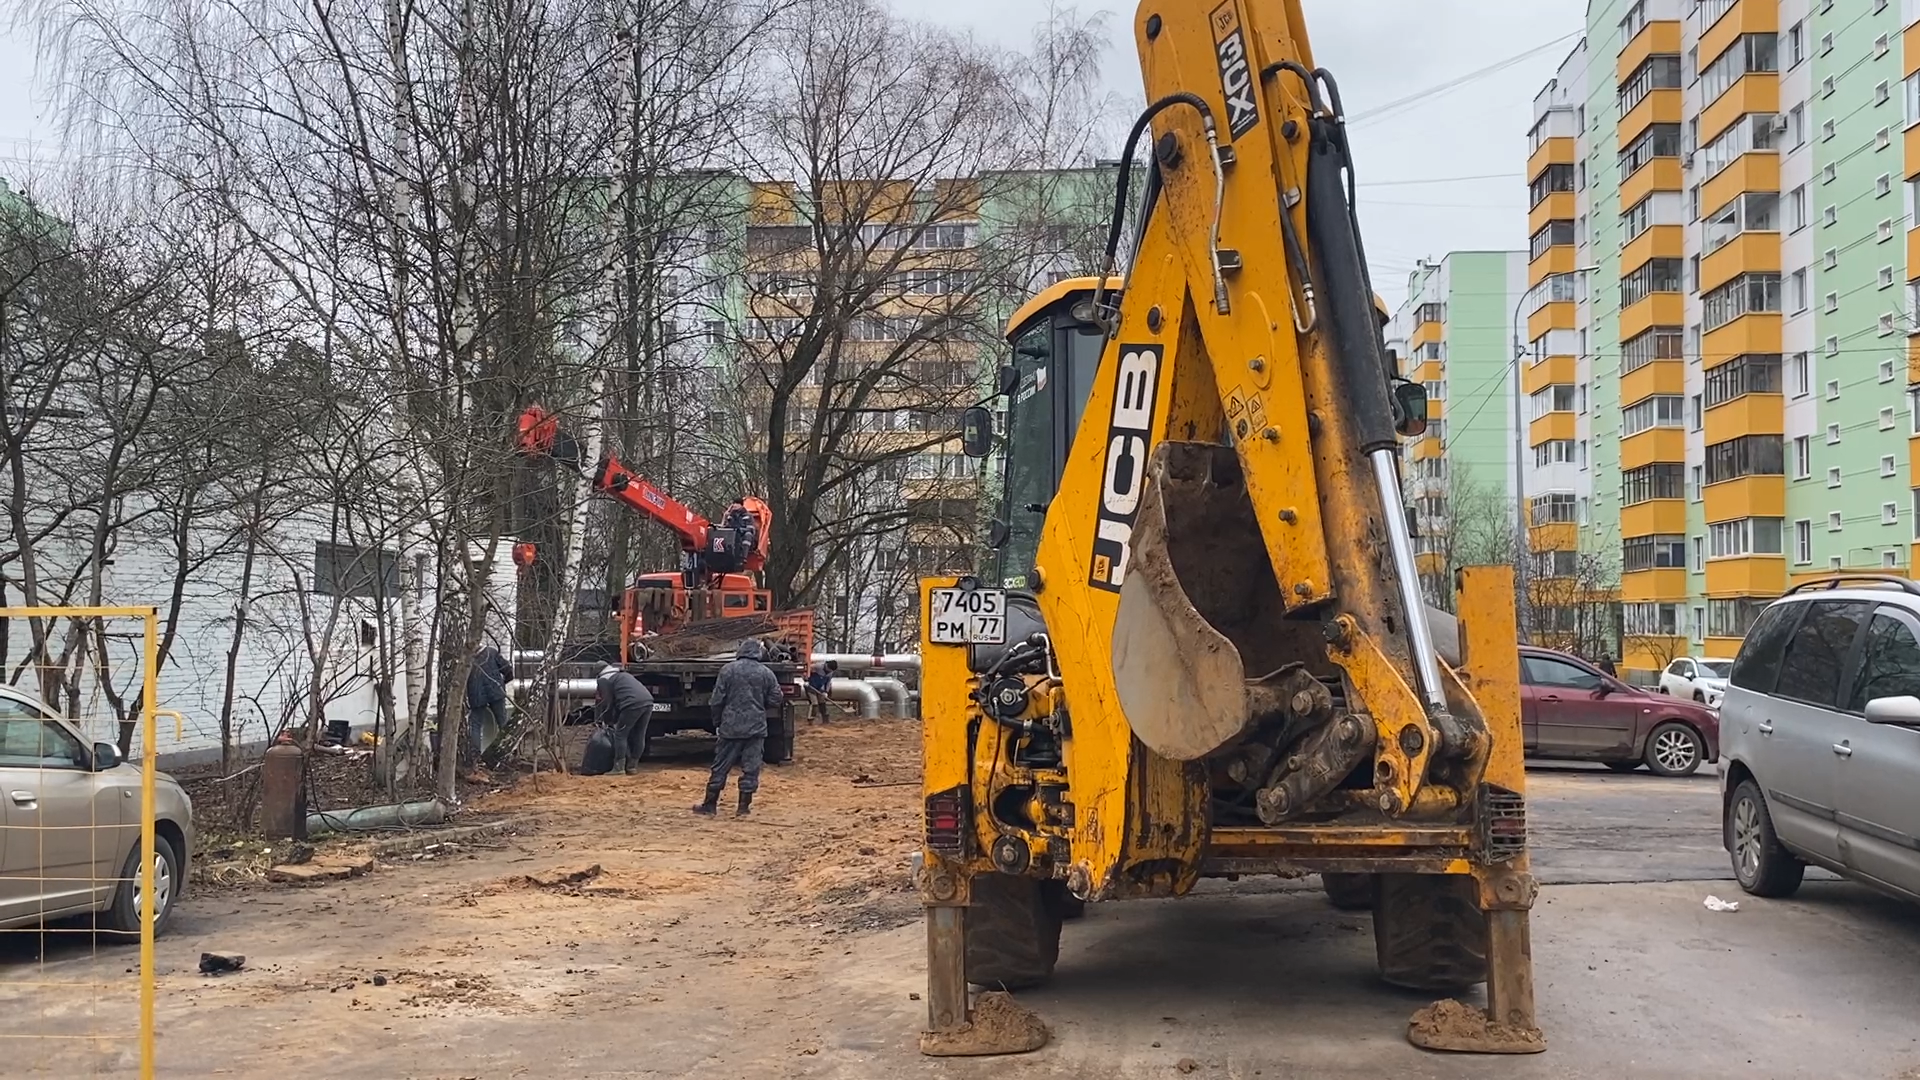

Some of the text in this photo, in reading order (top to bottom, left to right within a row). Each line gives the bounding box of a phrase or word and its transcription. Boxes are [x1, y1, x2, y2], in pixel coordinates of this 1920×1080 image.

[1219, 32, 1255, 126] 3CX
[1098, 350, 1157, 585] JCB
[942, 592, 996, 613] 7405
[978, 618, 999, 634] 77
